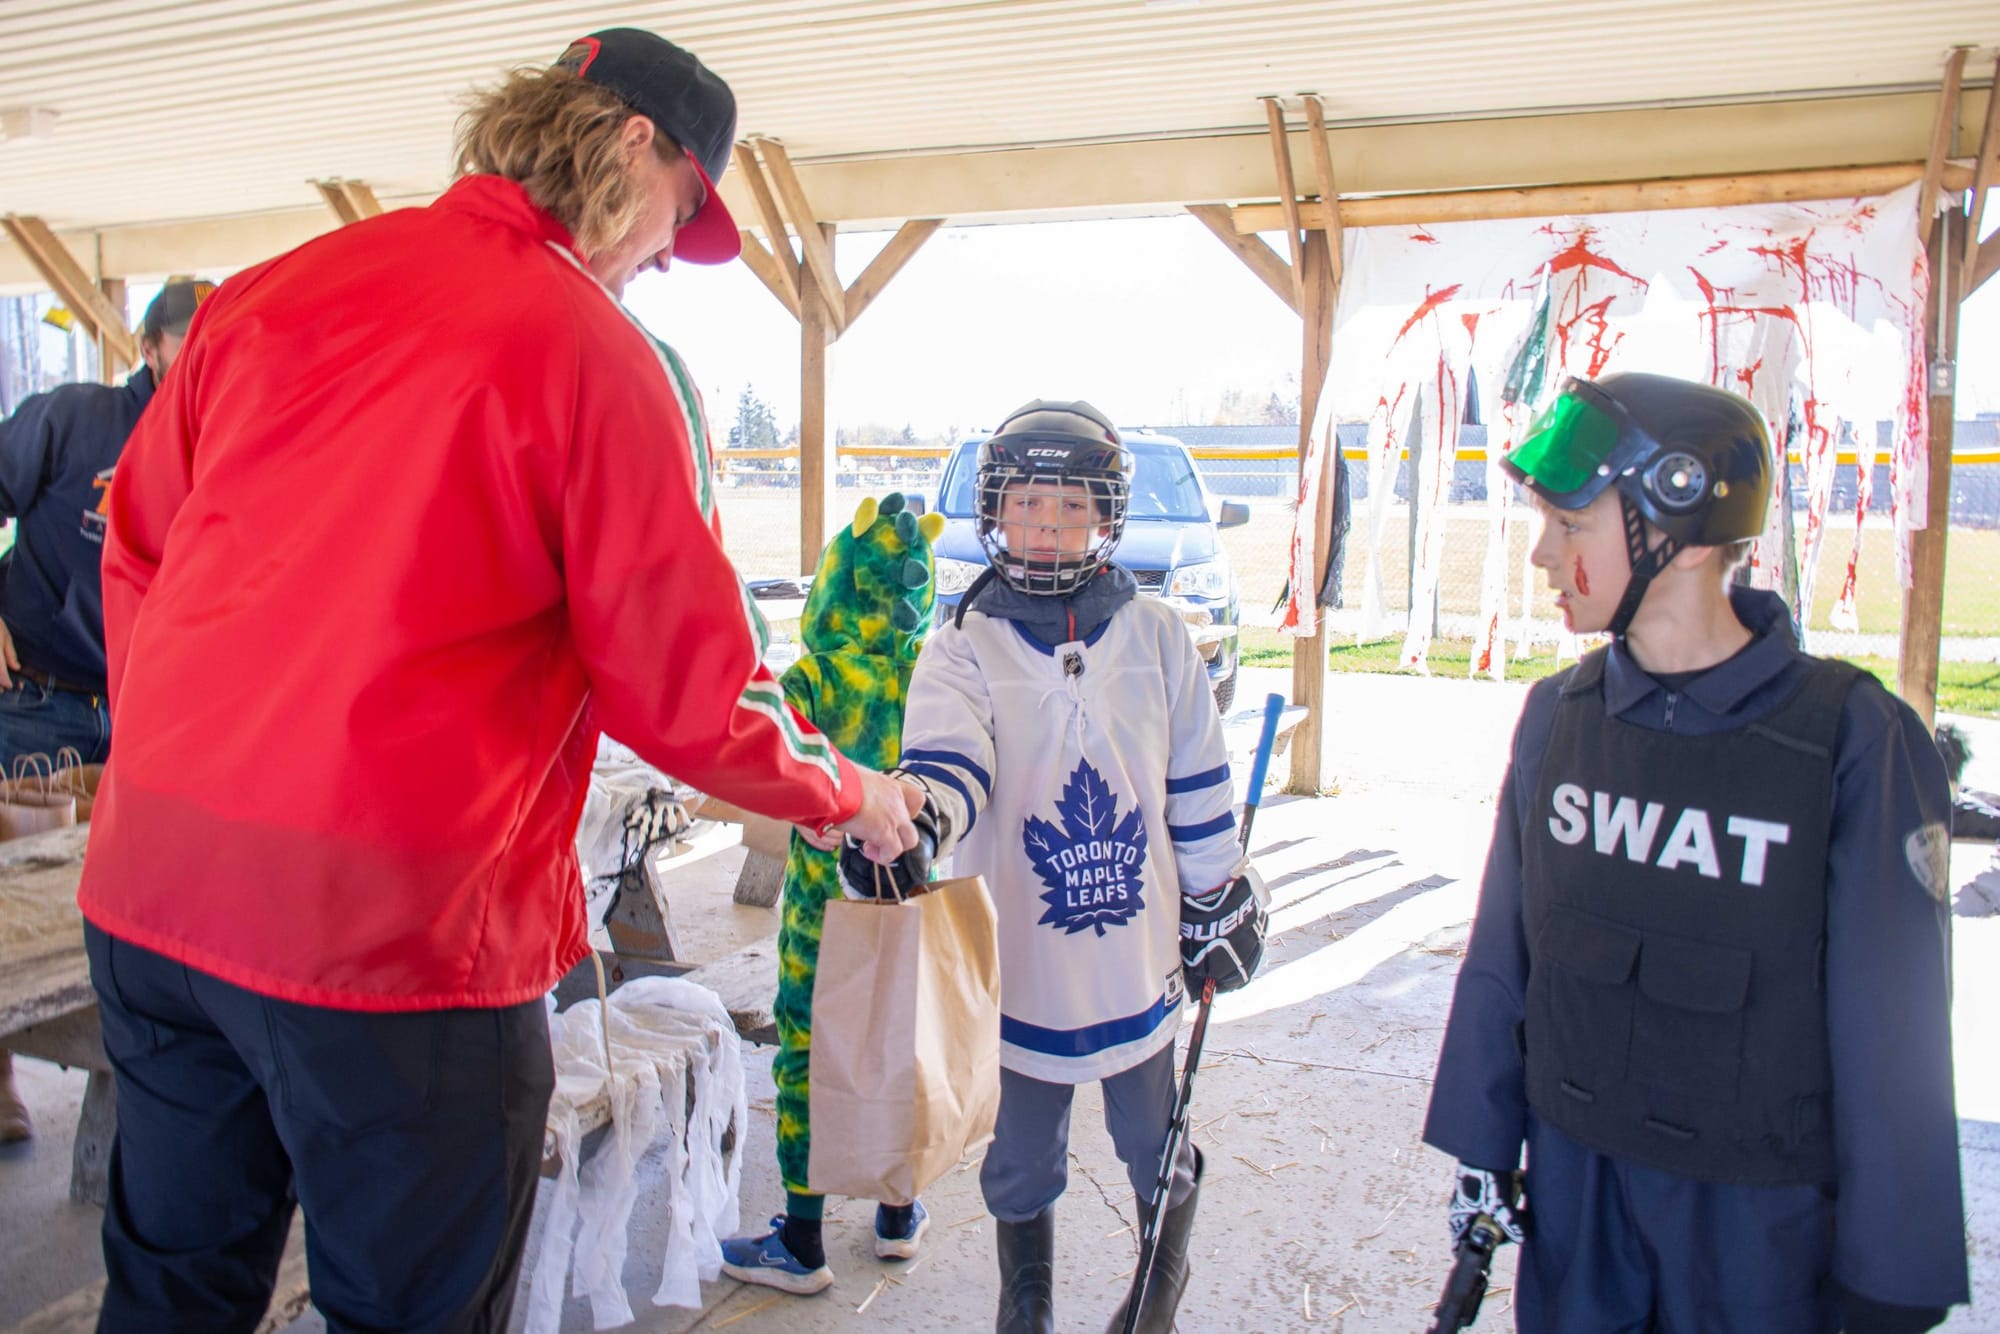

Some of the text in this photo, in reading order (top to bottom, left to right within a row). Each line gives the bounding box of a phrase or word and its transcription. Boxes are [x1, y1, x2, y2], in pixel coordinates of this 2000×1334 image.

[1026, 448, 1071, 458] CCM
[1548, 783, 1790, 887] SWAT
[1046, 841, 1138, 874] TORONTO
[1065, 863, 1126, 887] MAPLE
[1066, 883, 1128, 907] LEAFS
